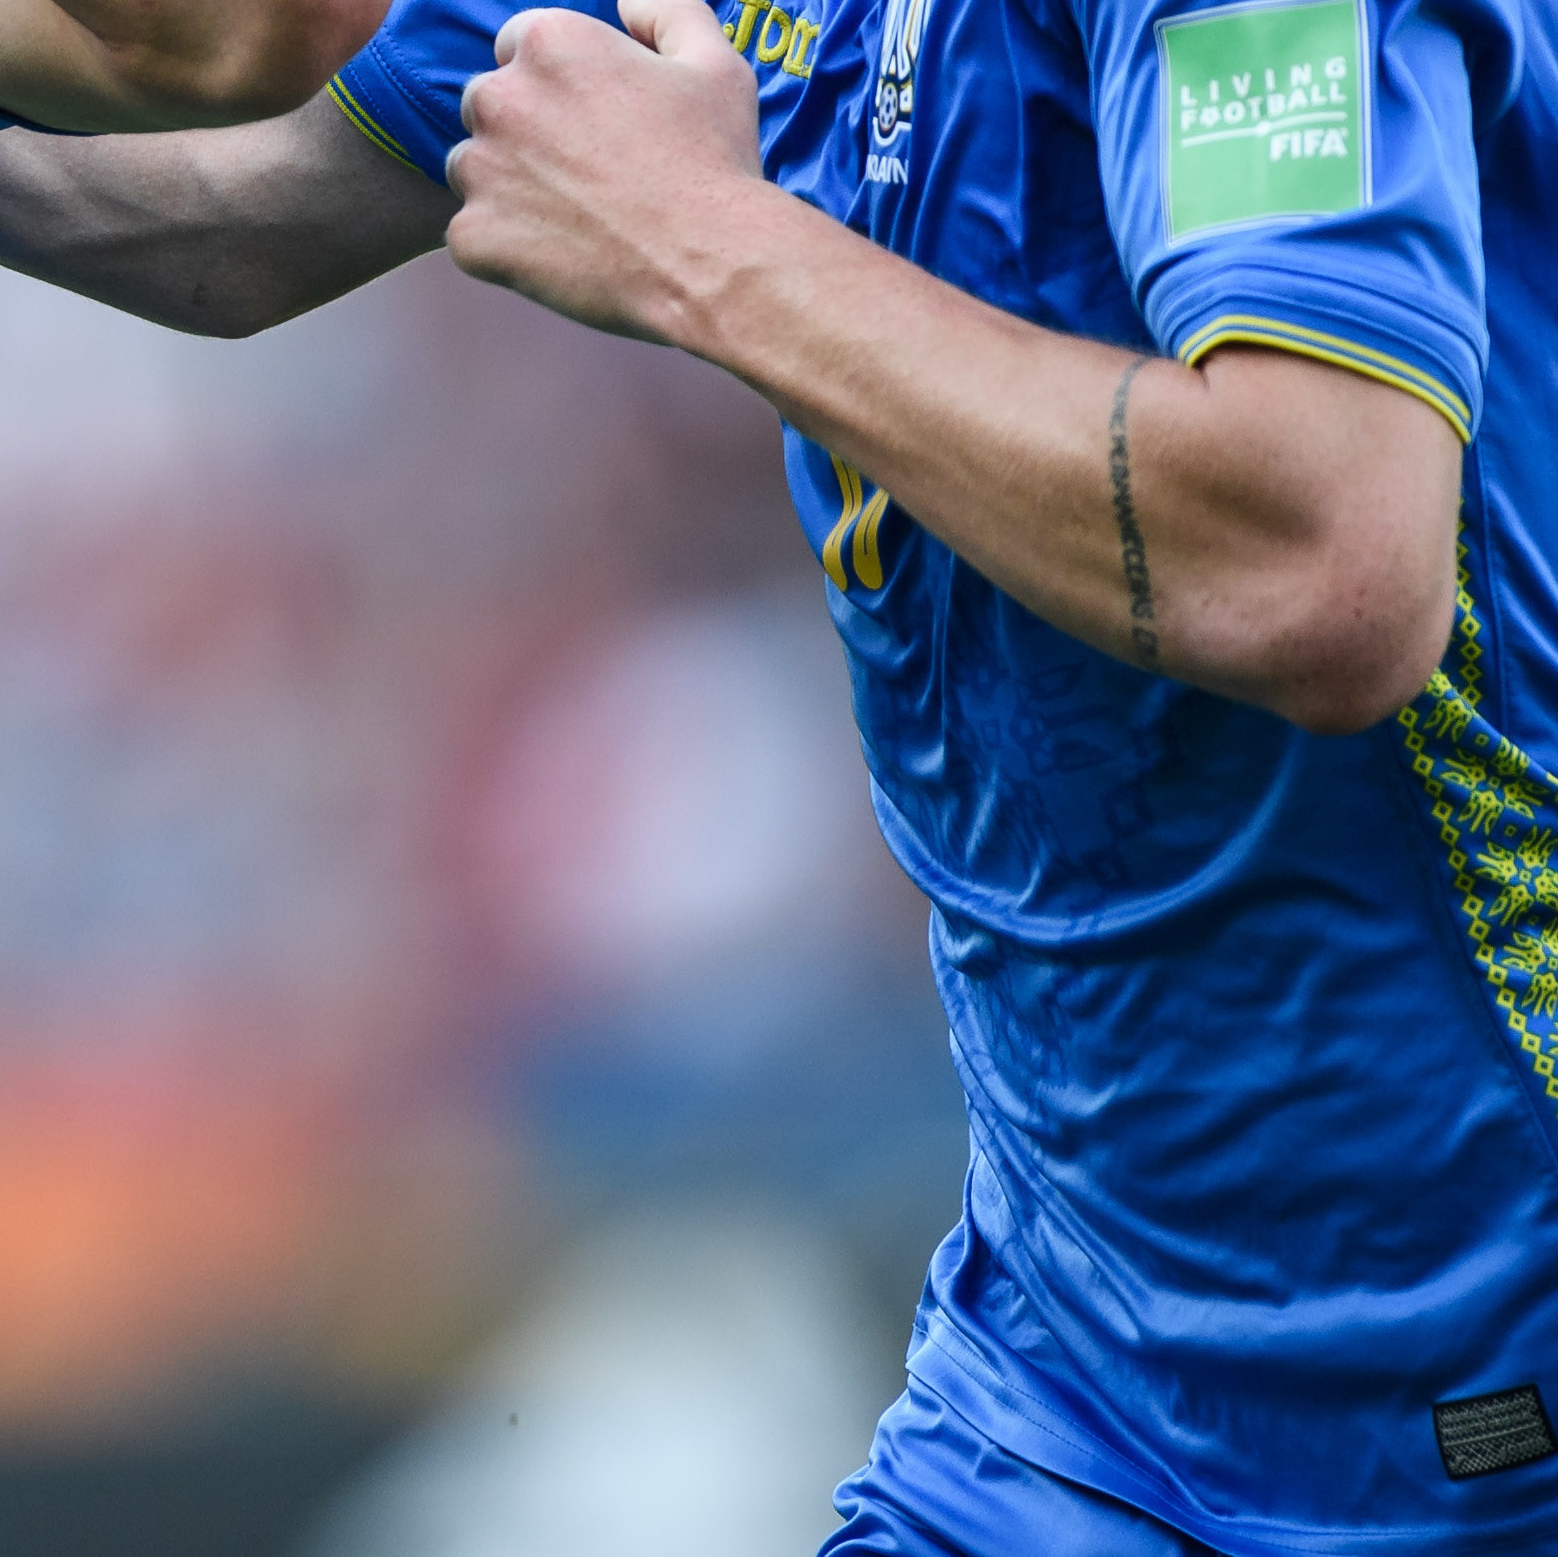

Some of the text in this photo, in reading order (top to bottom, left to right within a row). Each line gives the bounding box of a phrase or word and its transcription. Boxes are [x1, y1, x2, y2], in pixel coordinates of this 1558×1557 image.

[1180, 55, 1347, 107] LIVING
[1180, 81, 1348, 132] FOOTBALL
[1269, 127, 1348, 162] FIFA
[866, 153, 909, 186] RAIN
